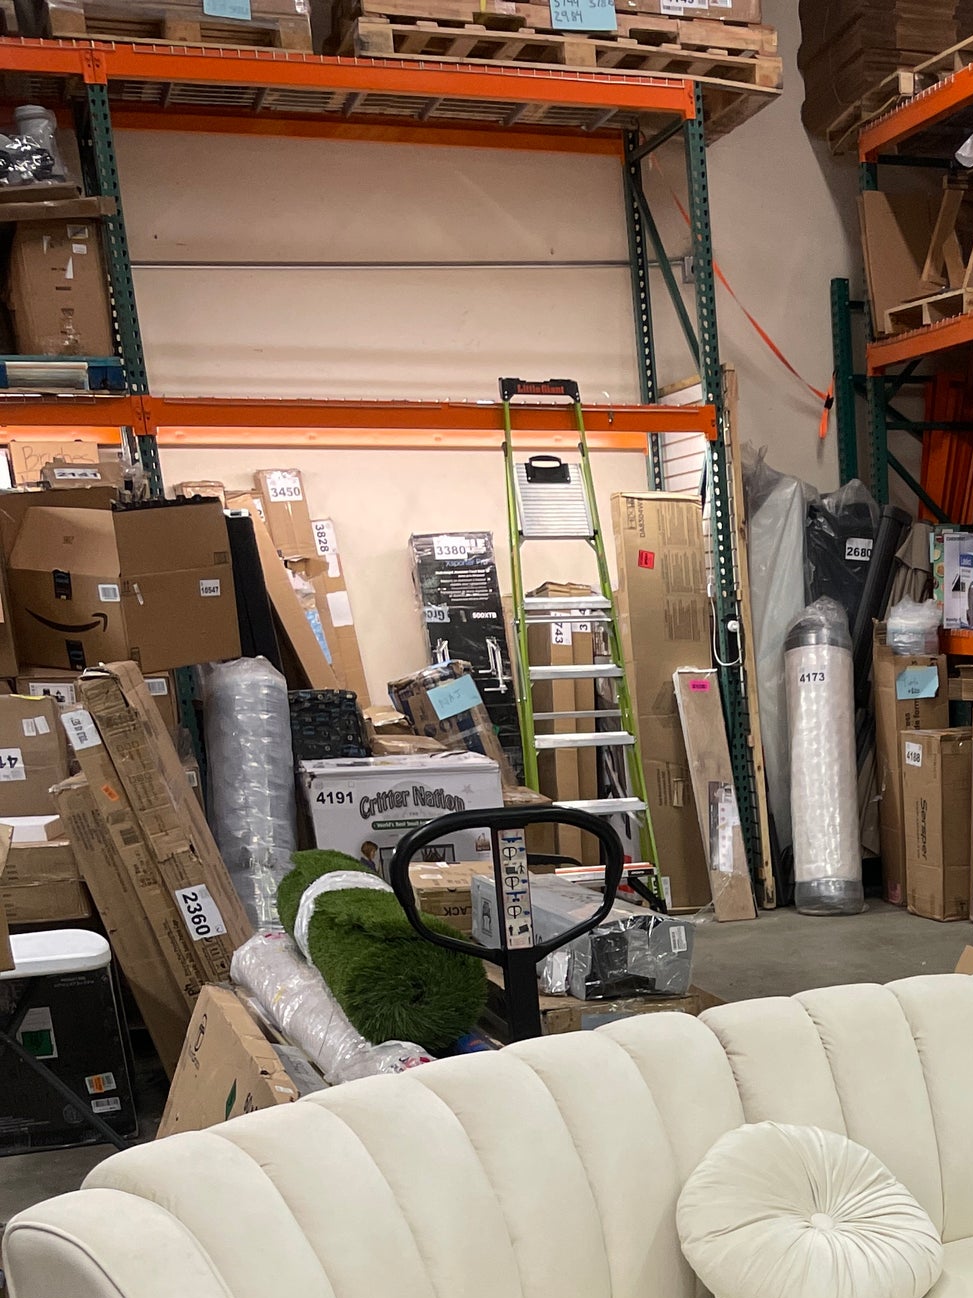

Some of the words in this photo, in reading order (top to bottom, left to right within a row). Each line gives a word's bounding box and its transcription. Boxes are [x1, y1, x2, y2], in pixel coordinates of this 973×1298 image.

[271, 487, 301, 499] 3450
[315, 523, 329, 553] 3828
[437, 545, 467, 556] 3380
[554, 613, 564, 644] 743
[799, 672, 826, 683] 4173
[316, 791, 355, 805] 4191
[359, 789, 410, 820] Critter
[411, 785, 467, 812] Nation
[181, 892, 212, 936] 2360
